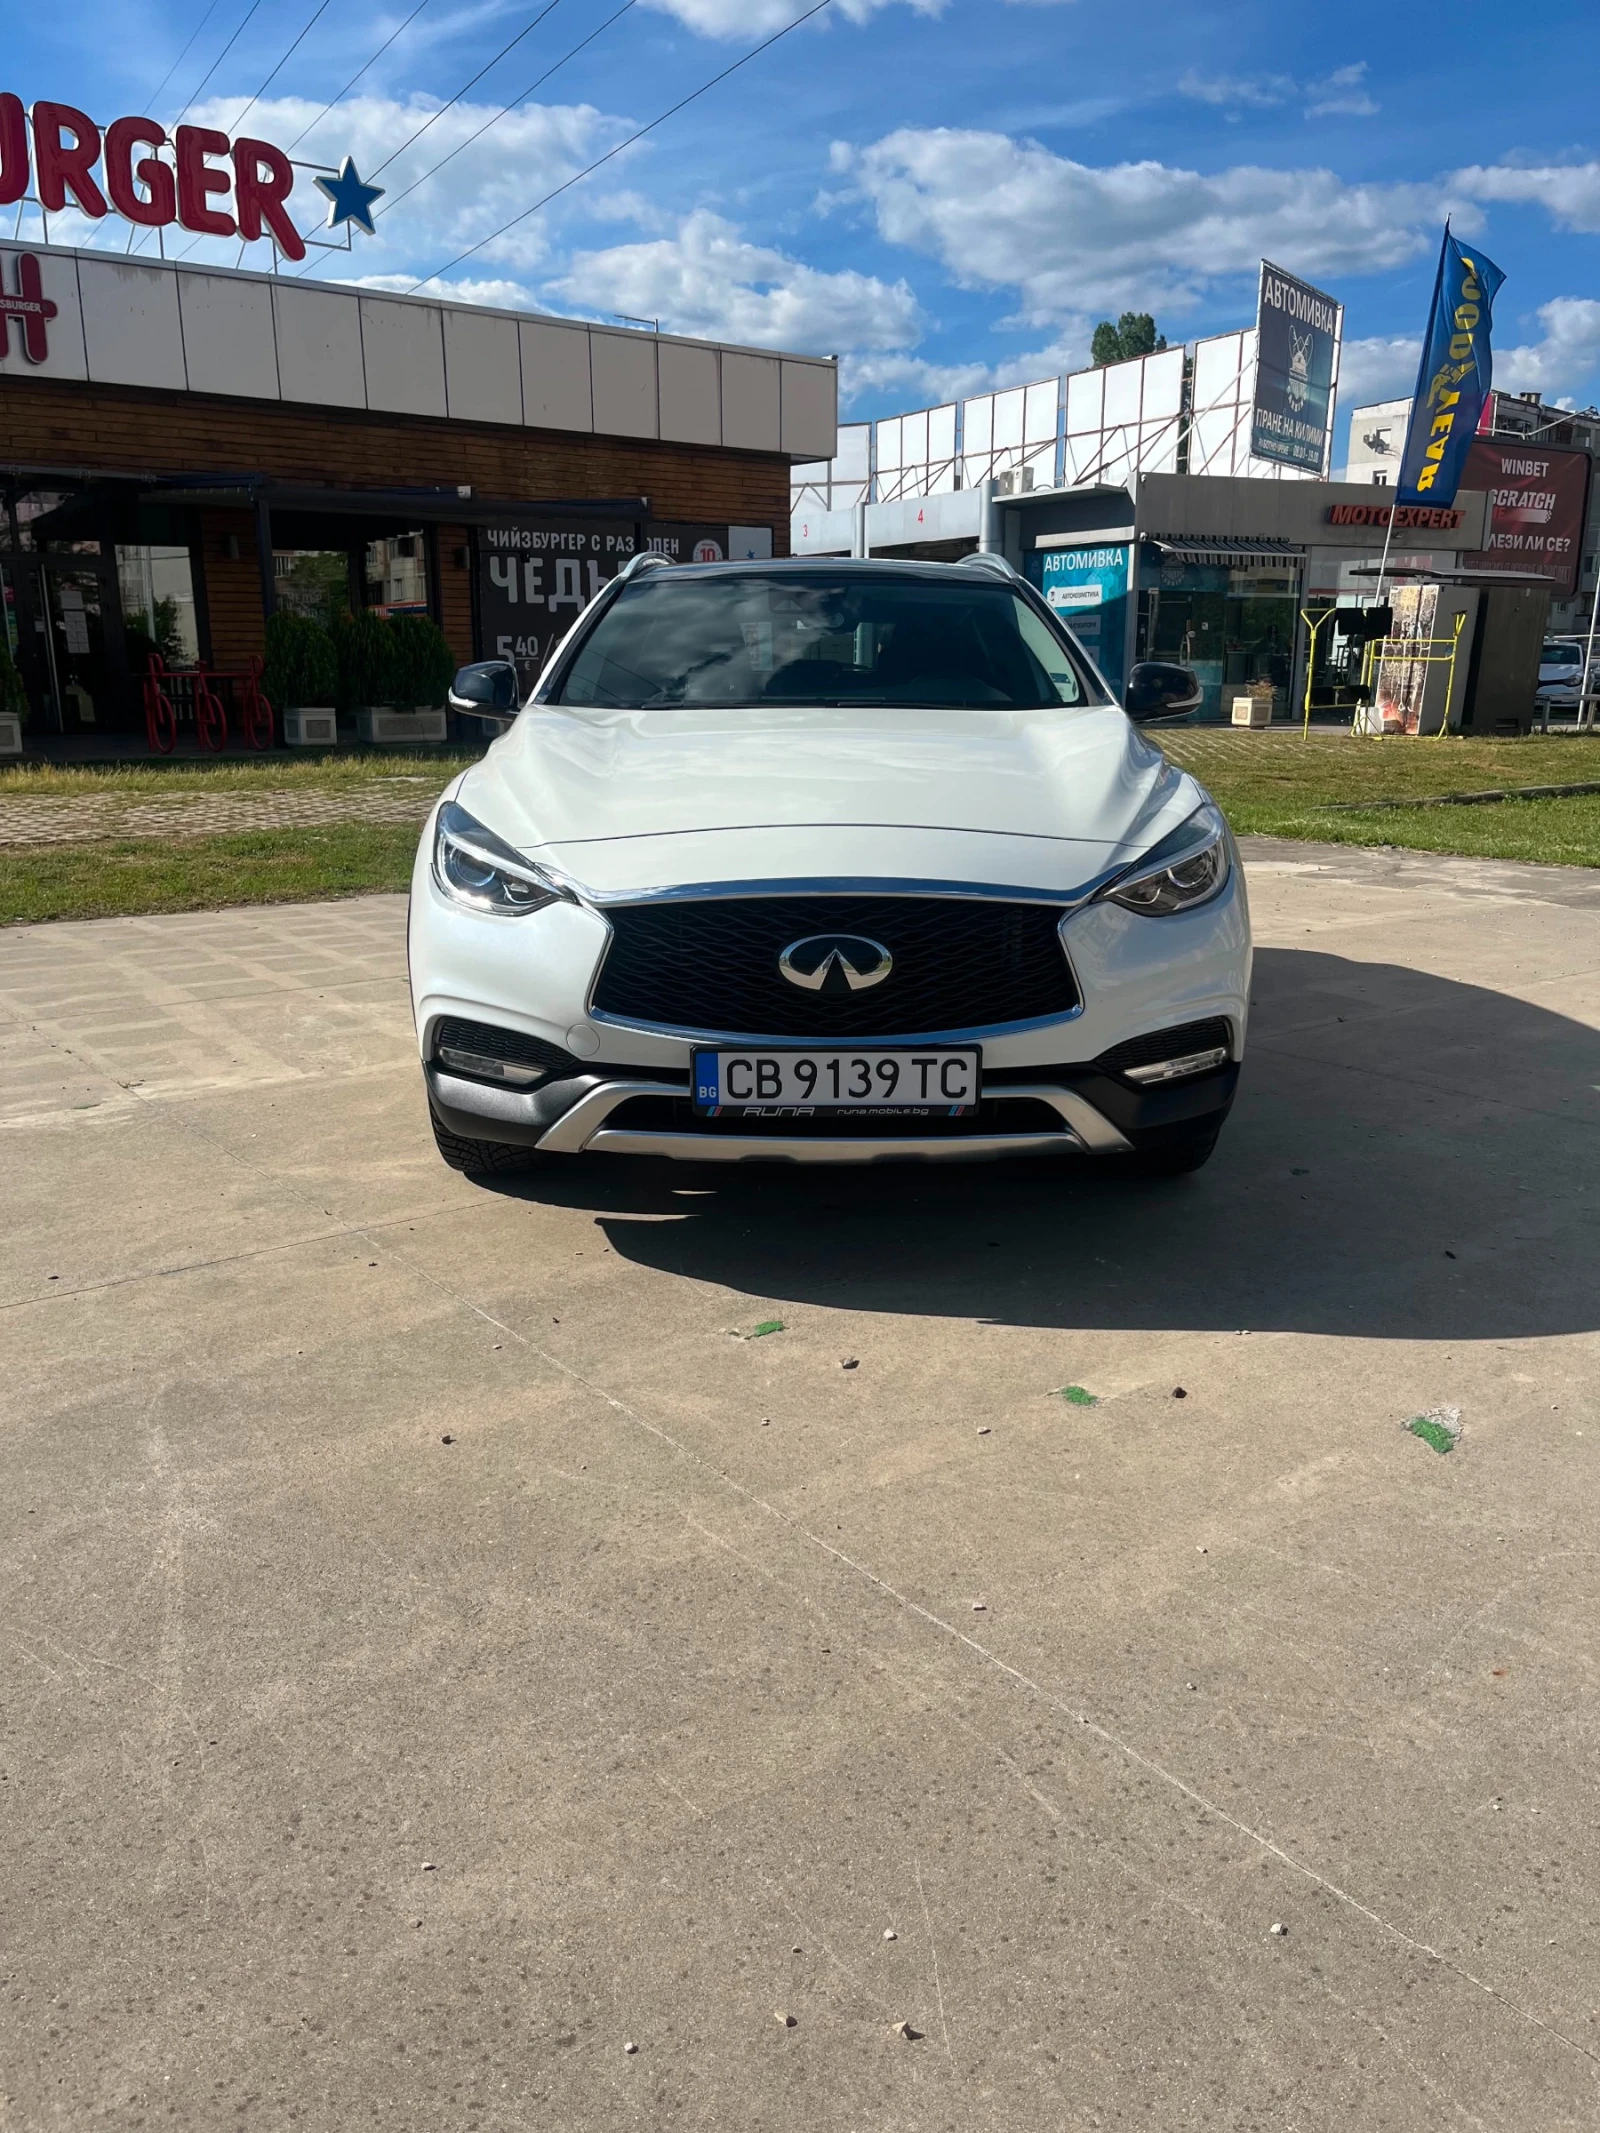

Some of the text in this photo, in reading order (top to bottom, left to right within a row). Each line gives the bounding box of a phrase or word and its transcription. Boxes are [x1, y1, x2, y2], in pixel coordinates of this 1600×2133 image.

[1264, 275, 1334, 336] АВТОМИВКА
[1256, 408, 1324, 447] ПРАНЕ НА КИЛИМИ
[1501, 458, 1549, 478] WINBET
[1490, 489, 1556, 510] SCRATCH
[917, 509, 924, 524] 4
[1332, 505, 1466, 529] MOTOEXPERT
[487, 526, 680, 554] ЧИЙЗБУРГЕР С РАЗПЕН
[803, 524, 808, 537] 3
[1488, 533, 1571, 552] ЛЕЗИ ЛИ СЕ?
[1044, 548, 1123, 572] АВТОМИВКА
[489, 556, 628, 613] ЧЕДЪ
[726, 1058, 968, 1099] CB 9139 TC
[699, 1086, 717, 1098] BG
[743, 1106, 816, 1117] RUNA
